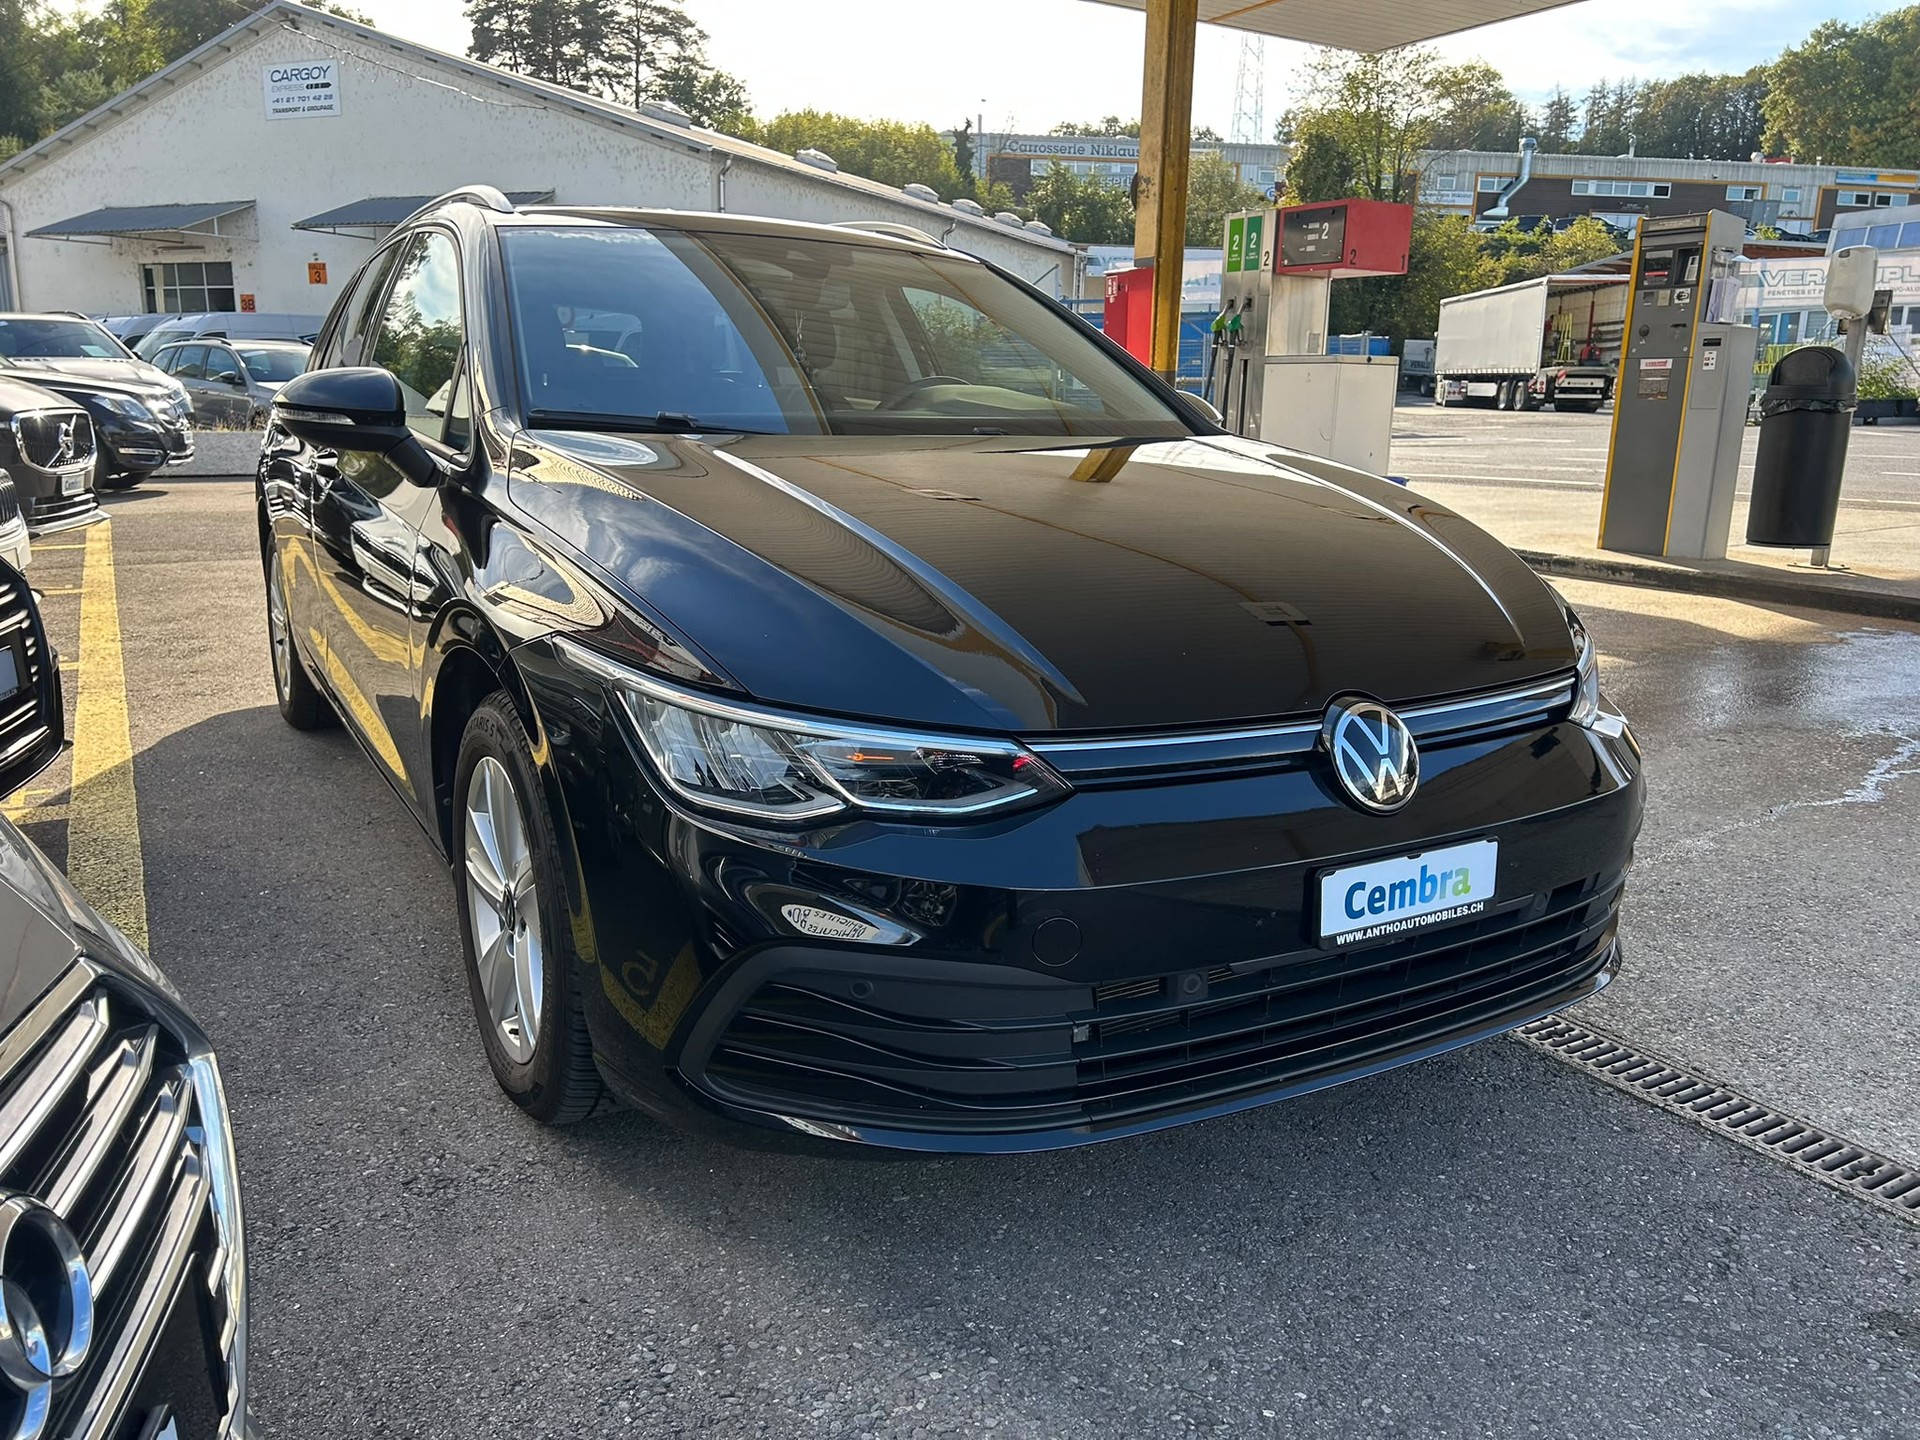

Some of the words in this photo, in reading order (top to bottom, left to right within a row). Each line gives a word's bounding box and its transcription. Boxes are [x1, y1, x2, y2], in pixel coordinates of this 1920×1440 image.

[270, 65, 331, 83] CARGOY
[271, 84, 304, 93] EXPRESS
[272, 106, 301, 114] TRANSPORT
[1008, 140, 1085, 155] Carrosserie
[1091, 144, 1140, 157] Niklaus
[1321, 222, 1329, 239] 2
[1232, 234, 1239, 250] 2
[1250, 232, 1257, 248] 2
[1263, 250, 1270, 267] 2
[1350, 248, 1357, 265] 2
[1401, 254, 1406, 270] 1
[314, 270, 322, 283] 3
[241, 299, 255, 310] 3B
[489, 723, 496, 737] 5
[1344, 864, 1471, 920] Cembra
[1336, 901, 1485, 945] WWW.ANTHOAUTOMOBILES.CH
